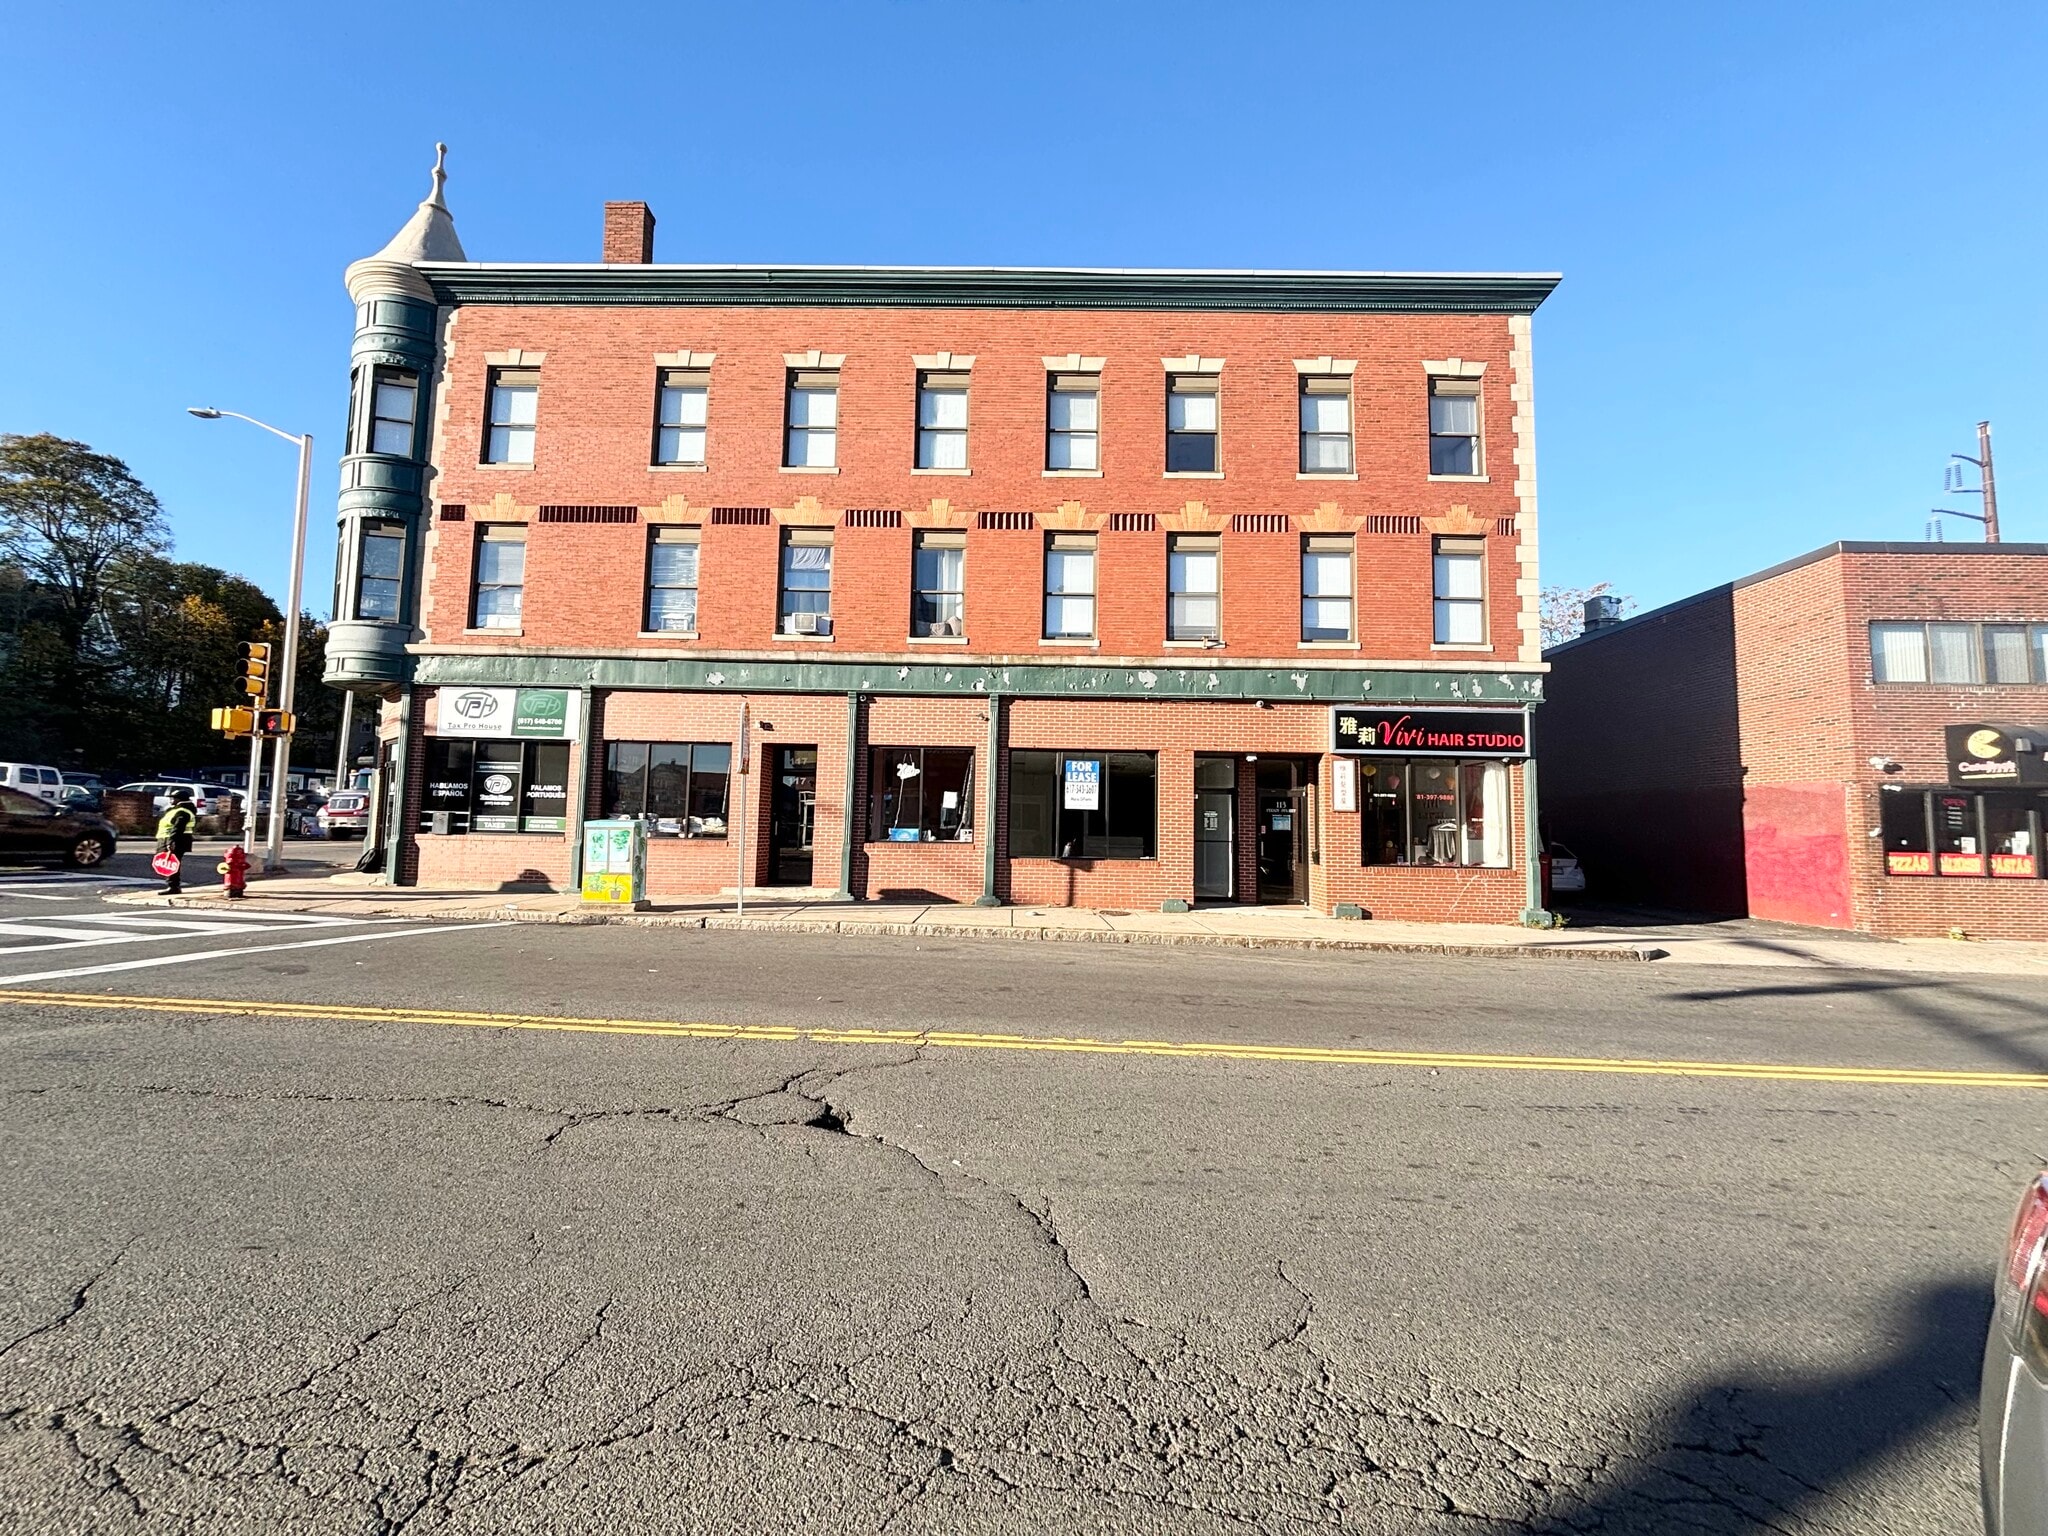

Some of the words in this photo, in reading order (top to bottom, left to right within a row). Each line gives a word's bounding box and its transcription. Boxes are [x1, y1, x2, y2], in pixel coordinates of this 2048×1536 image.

[1339, 716, 1376, 745] 雅莉
[1377, 715, 1425, 746] Vivi
[1427, 733, 1464, 746] HAIR
[1467, 734, 1524, 747] STUDIO
[1071, 761, 1093, 772] FOR
[1067, 772, 1097, 783] LEASE
[430, 782, 468, 790] HABLAMOS
[432, 789, 465, 797] ESPAÑOL
[154, 858, 177, 871] STOP
